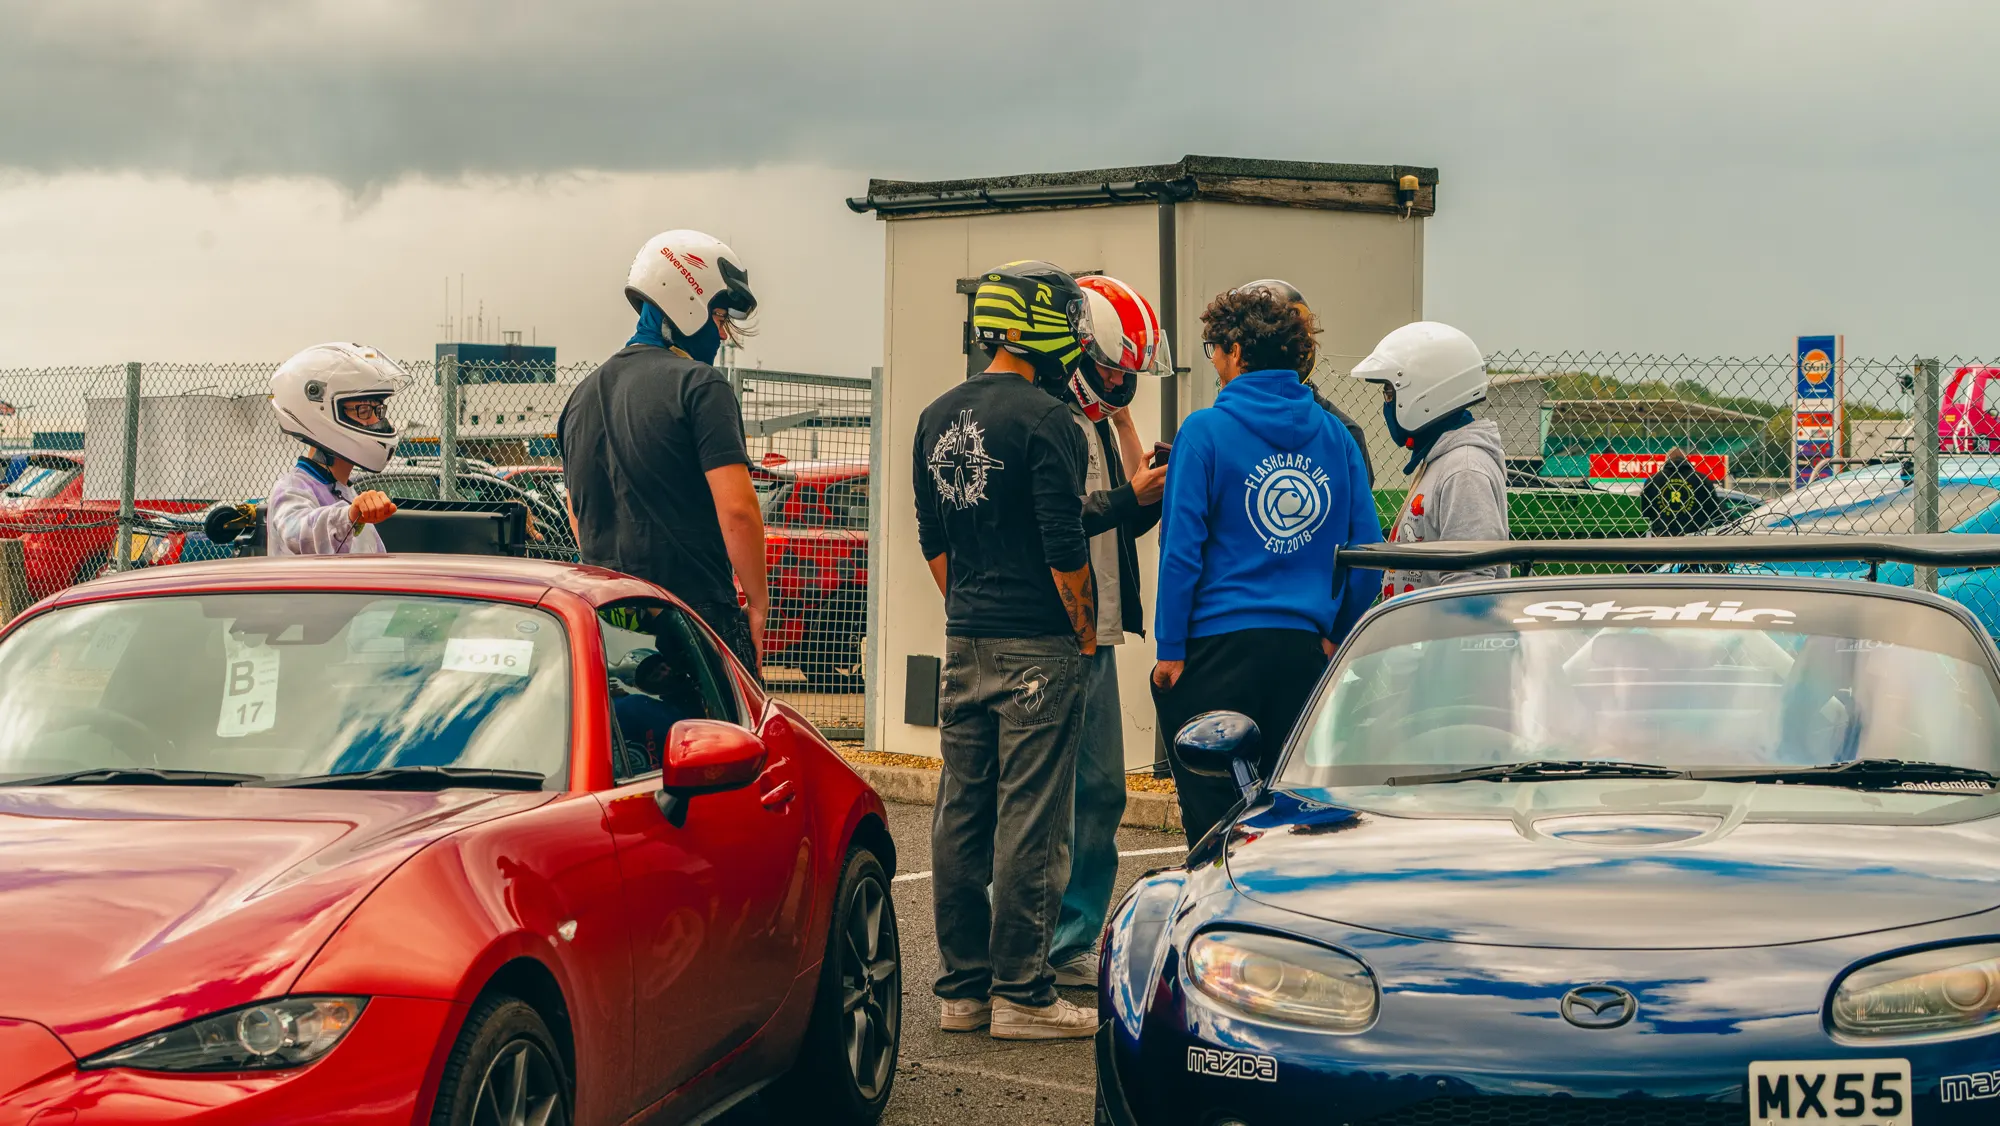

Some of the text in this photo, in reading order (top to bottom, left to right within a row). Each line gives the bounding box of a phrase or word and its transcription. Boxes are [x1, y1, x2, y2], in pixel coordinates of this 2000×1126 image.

[660, 247, 704, 296] Silverstone
[1803, 362, 1829, 373] Gulf
[1670, 491, 1682, 504] R
[1512, 600, 1797, 625] Static
[229, 660, 255, 697] B
[236, 700, 264, 725] 17
[1901, 779, 1991, 791] @nicemiata
[1757, 1072, 1903, 1119] MX55
